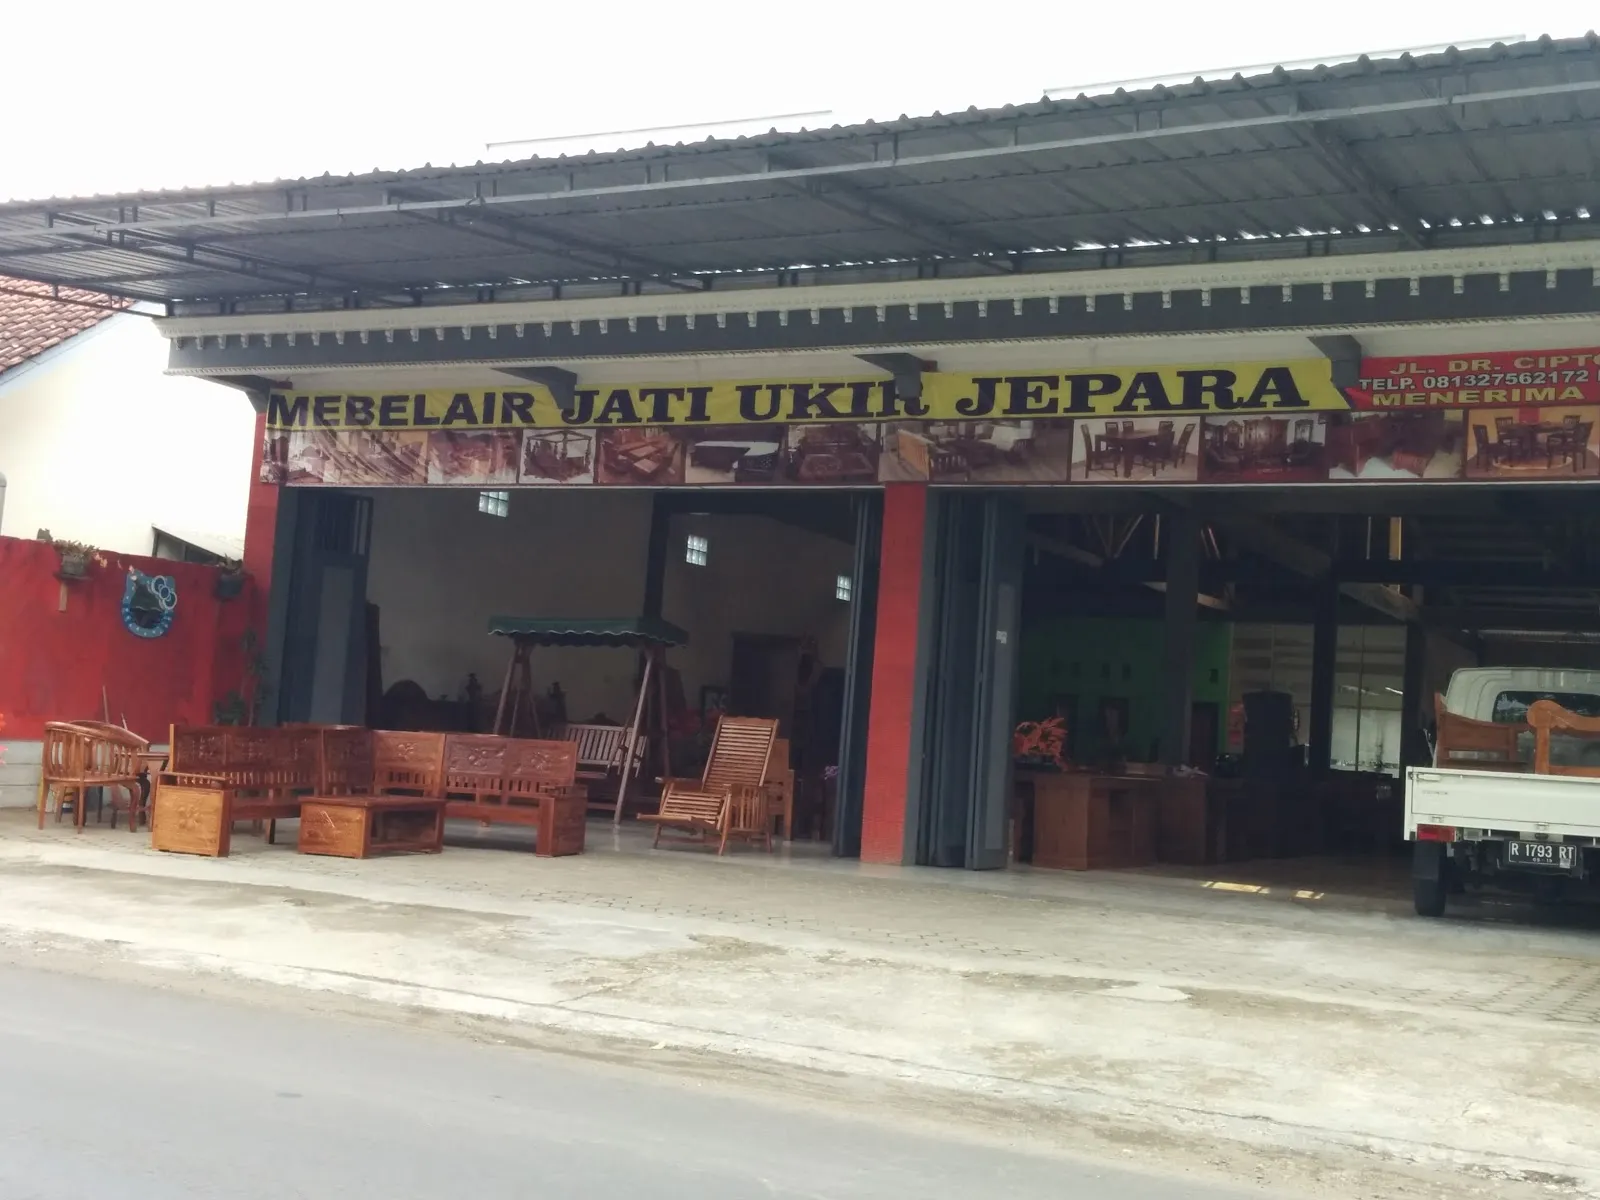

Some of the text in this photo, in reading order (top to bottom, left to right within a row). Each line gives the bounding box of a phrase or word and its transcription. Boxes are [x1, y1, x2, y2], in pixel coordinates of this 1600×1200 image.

[1390, 363, 1436, 375] JL.
[1449, 359, 1501, 372] DR.
[1360, 378, 1416, 390] TELP.
[1424, 370, 1589, 388] 081327562172
[268, 393, 536, 426] MEBELAIR
[562, 388, 713, 424] JATI
[956, 367, 1309, 416] JEPARA
[1372, 386, 1585, 406] MENERIMA
[1511, 842, 1575, 859] R 1793 RT
